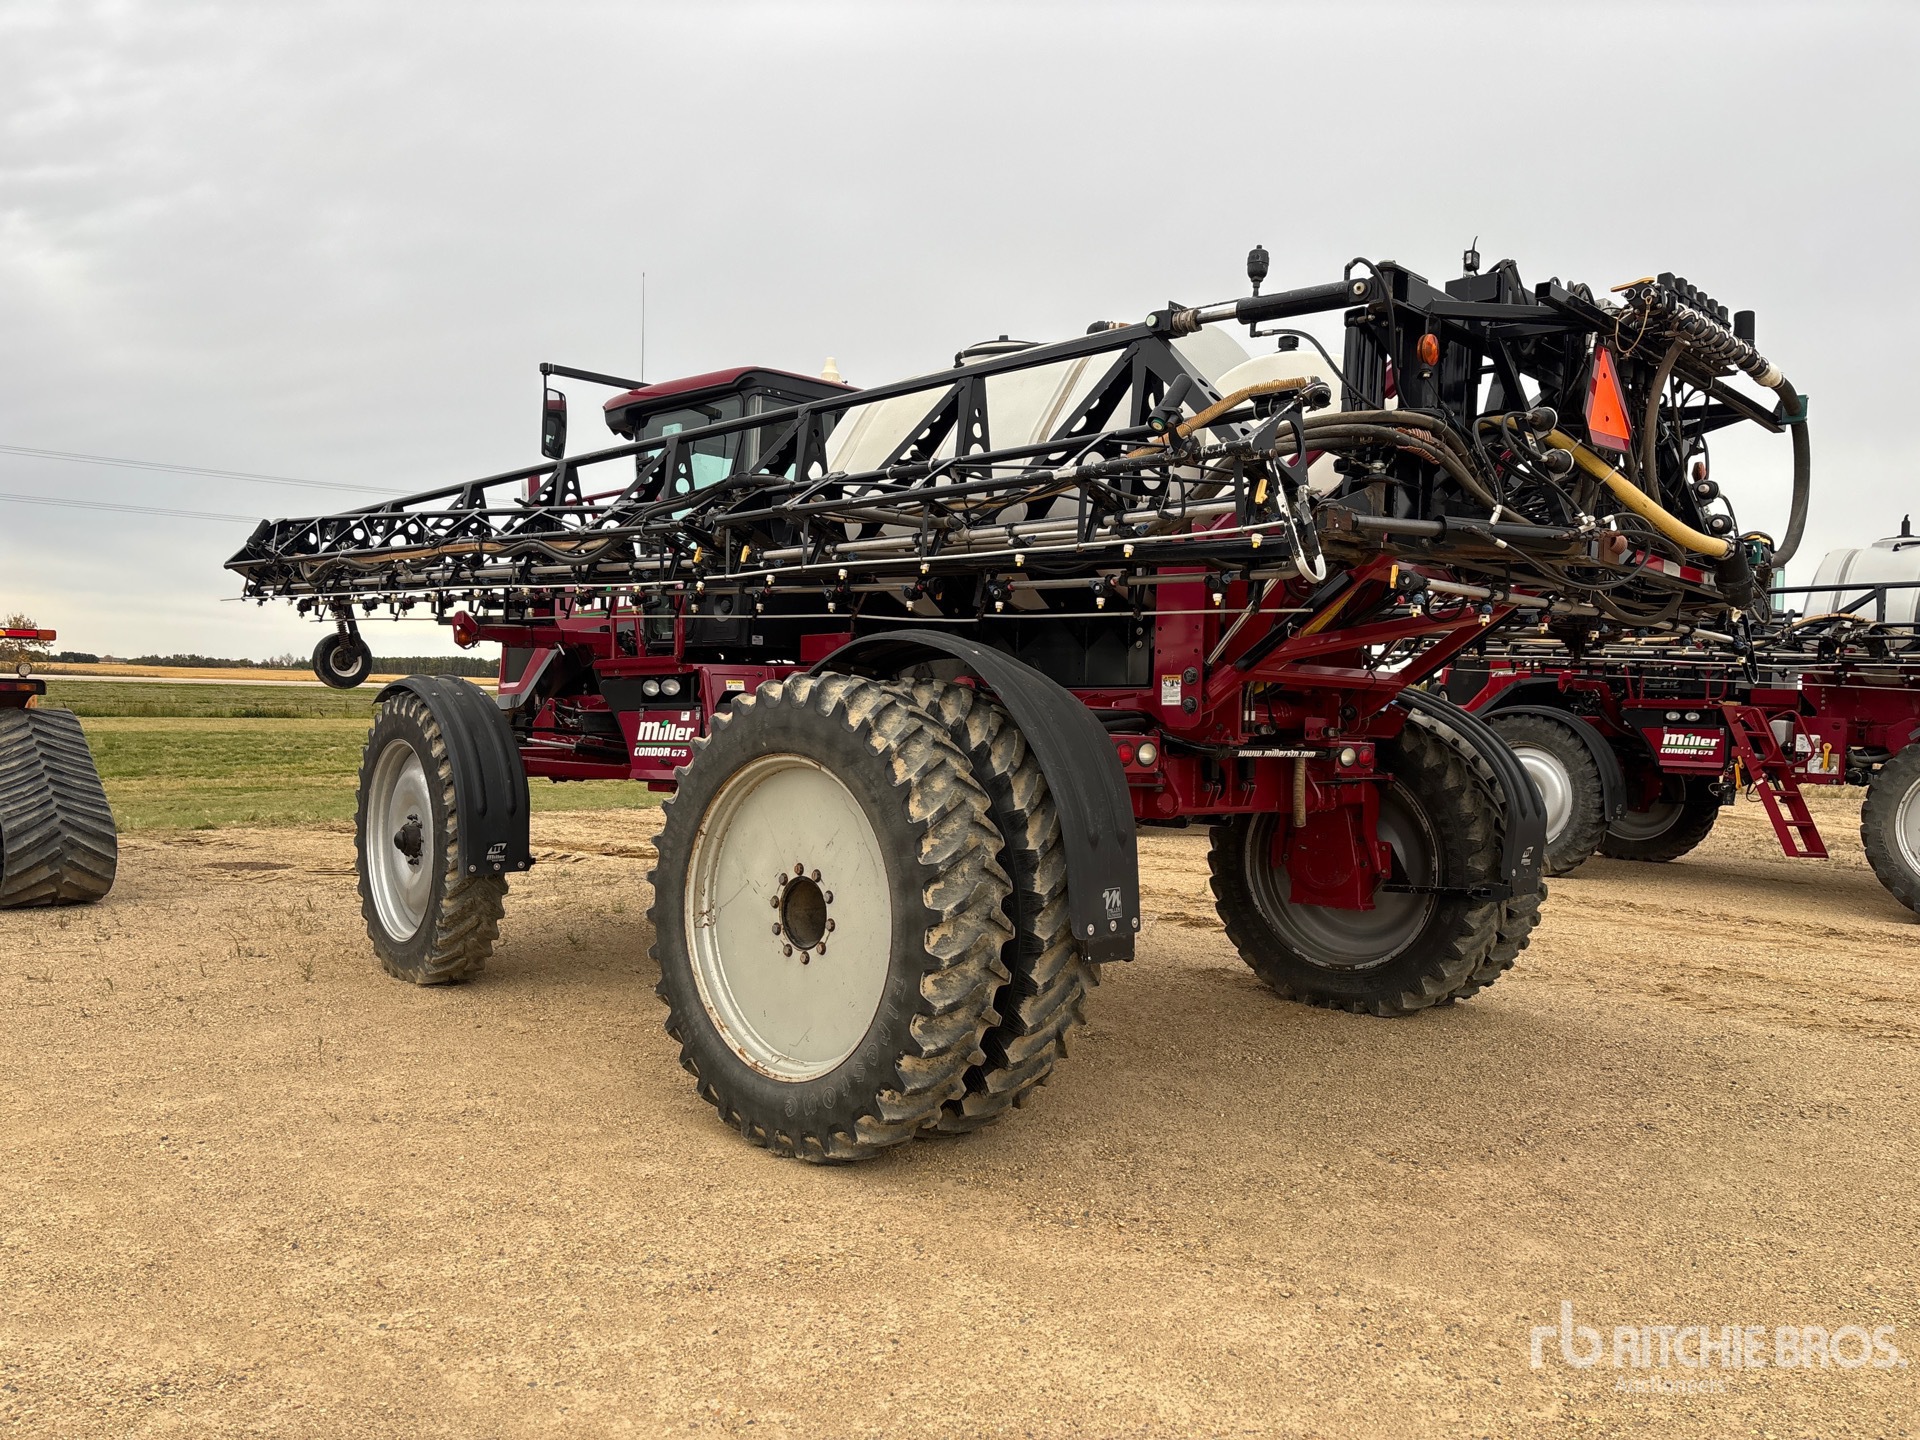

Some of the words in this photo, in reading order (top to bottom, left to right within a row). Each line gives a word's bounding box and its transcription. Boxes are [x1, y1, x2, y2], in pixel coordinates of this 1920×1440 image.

[637, 720, 695, 741] Miller
[1662, 734, 1719, 746] Miller
[634, 747, 671, 757] CONDOR
[671, 749, 687, 757] G75
[1660, 747, 1697, 755] CONDOR
[783, 974, 908, 1118] Firestone
